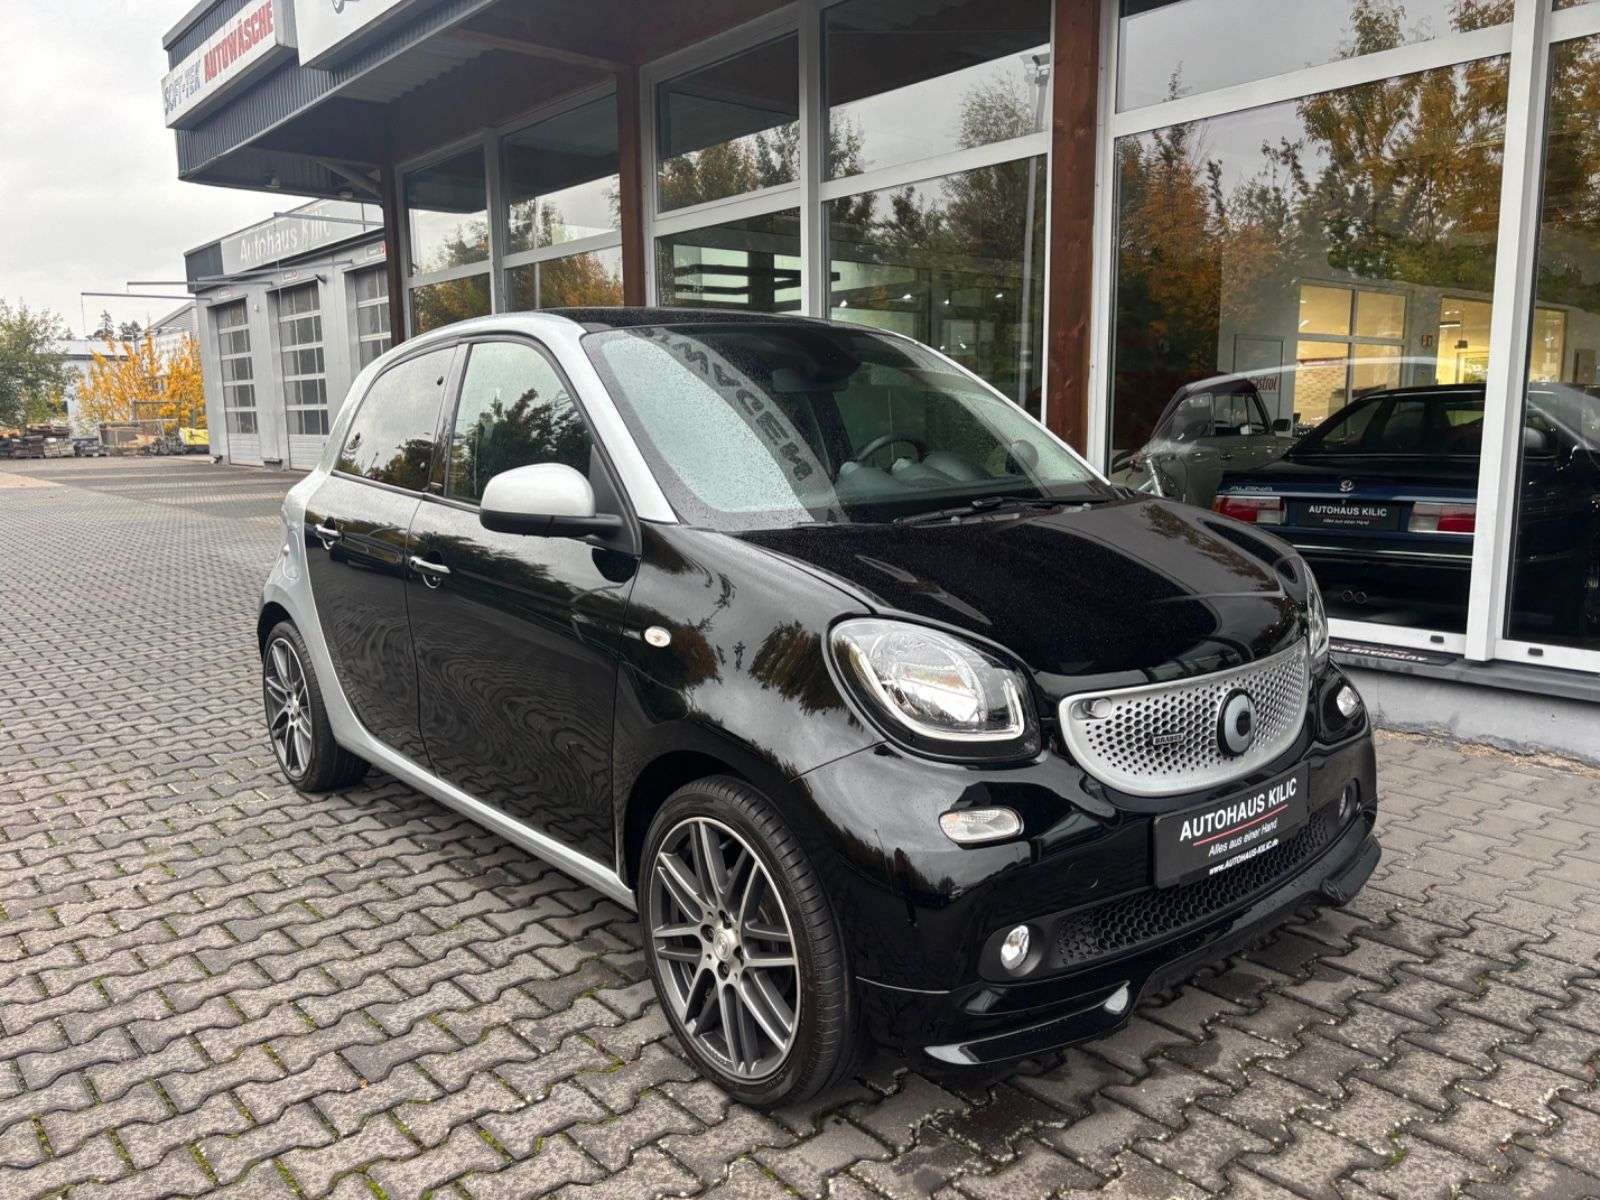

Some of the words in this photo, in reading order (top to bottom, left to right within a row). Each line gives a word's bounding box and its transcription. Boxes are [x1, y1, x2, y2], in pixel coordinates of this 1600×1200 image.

[203, 0, 274, 84] AUTOWÄSCHE
[240, 226, 298, 261] Autohaus
[1308, 505, 1360, 516] AUTOHAUS
[1361, 507, 1388, 517] KILIC
[1179, 793, 1266, 843] AUTOHAUS
[1267, 777, 1298, 808] KILIC
[1261, 818, 1279, 836] Hand
